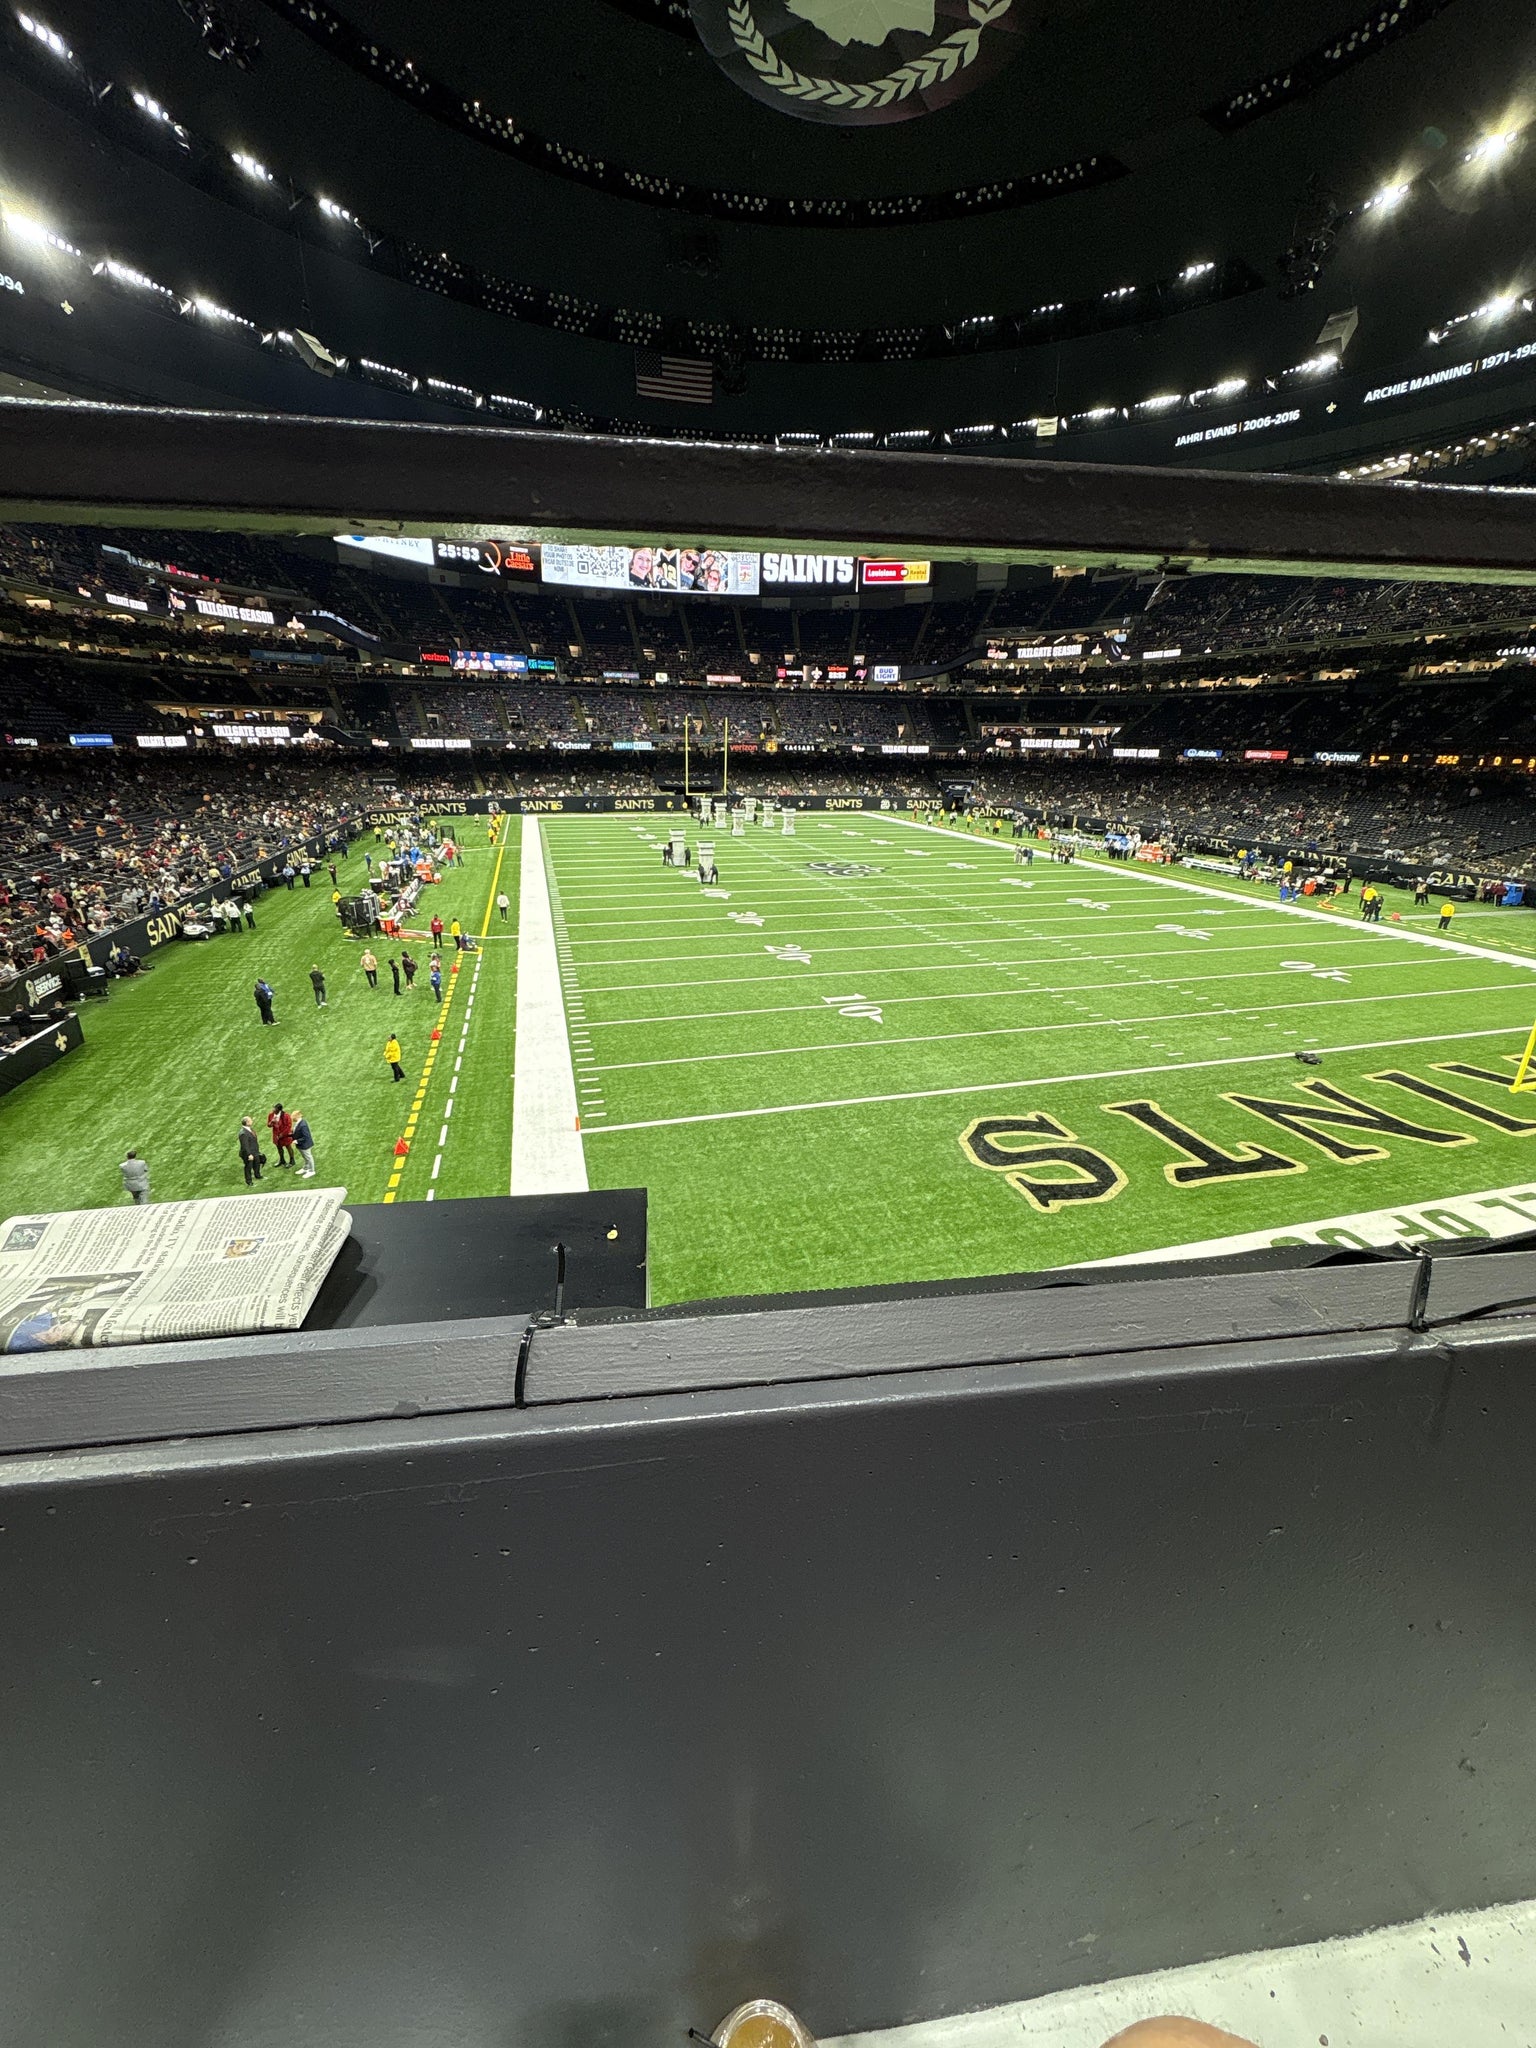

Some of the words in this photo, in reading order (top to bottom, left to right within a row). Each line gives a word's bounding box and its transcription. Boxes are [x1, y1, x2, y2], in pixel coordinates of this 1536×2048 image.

[1363, 381, 1408, 403] ARCHIE
[1409, 363, 1472, 391] MANNING
[1481, 343, 1536, 370] 1971-198
[1174, 432, 1203, 447] JAHRI
[1205, 424, 1237, 441] EVANS
[437, 542, 480, 561] 25:53
[510, 551, 530, 562] Little
[505, 559, 534, 571] Caesars
[762, 553, 854, 583] SAINTS
[868, 569, 897, 577] Louisiana
[195, 599, 239, 619] TAILGATE
[240, 607, 274, 624] SEASON
[421, 653, 450, 662] verizon
[1017, 646, 1052, 659] TAILGATE
[1052, 644, 1082, 657] SEASON
[1496, 646, 1536, 656] CAESAR
[212, 725, 255, 737] TAILGATE
[254, 726, 290, 738] SEASON
[14, 737, 38, 747] entergy
[557, 741, 591, 750] Ochsner
[1020, 738, 1052, 748] TAILGATE
[1053, 739, 1080, 748] SEASON
[1320, 752, 1360, 762] Ochsner
[419, 802, 466, 814] SAINTS
[614, 799, 655, 810] SAINTS
[825, 799, 863, 809] SAINTS
[906, 800, 942, 809] SAINTS
[972, 806, 1006, 818] SAINT
[35, 975, 61, 995] SERVICE
[170, 1215, 187, 1236] radio,
[165, 1235, 179, 1249] TV
[145, 1251, 169, 1278] stations
[278, 1255, 306, 1304] consequences
[124, 1279, 150, 1302] grapple
[109, 1302, 130, 1319] with
[275, 1305, 286, 1320] will
[288, 1313, 299, 1329] yet
